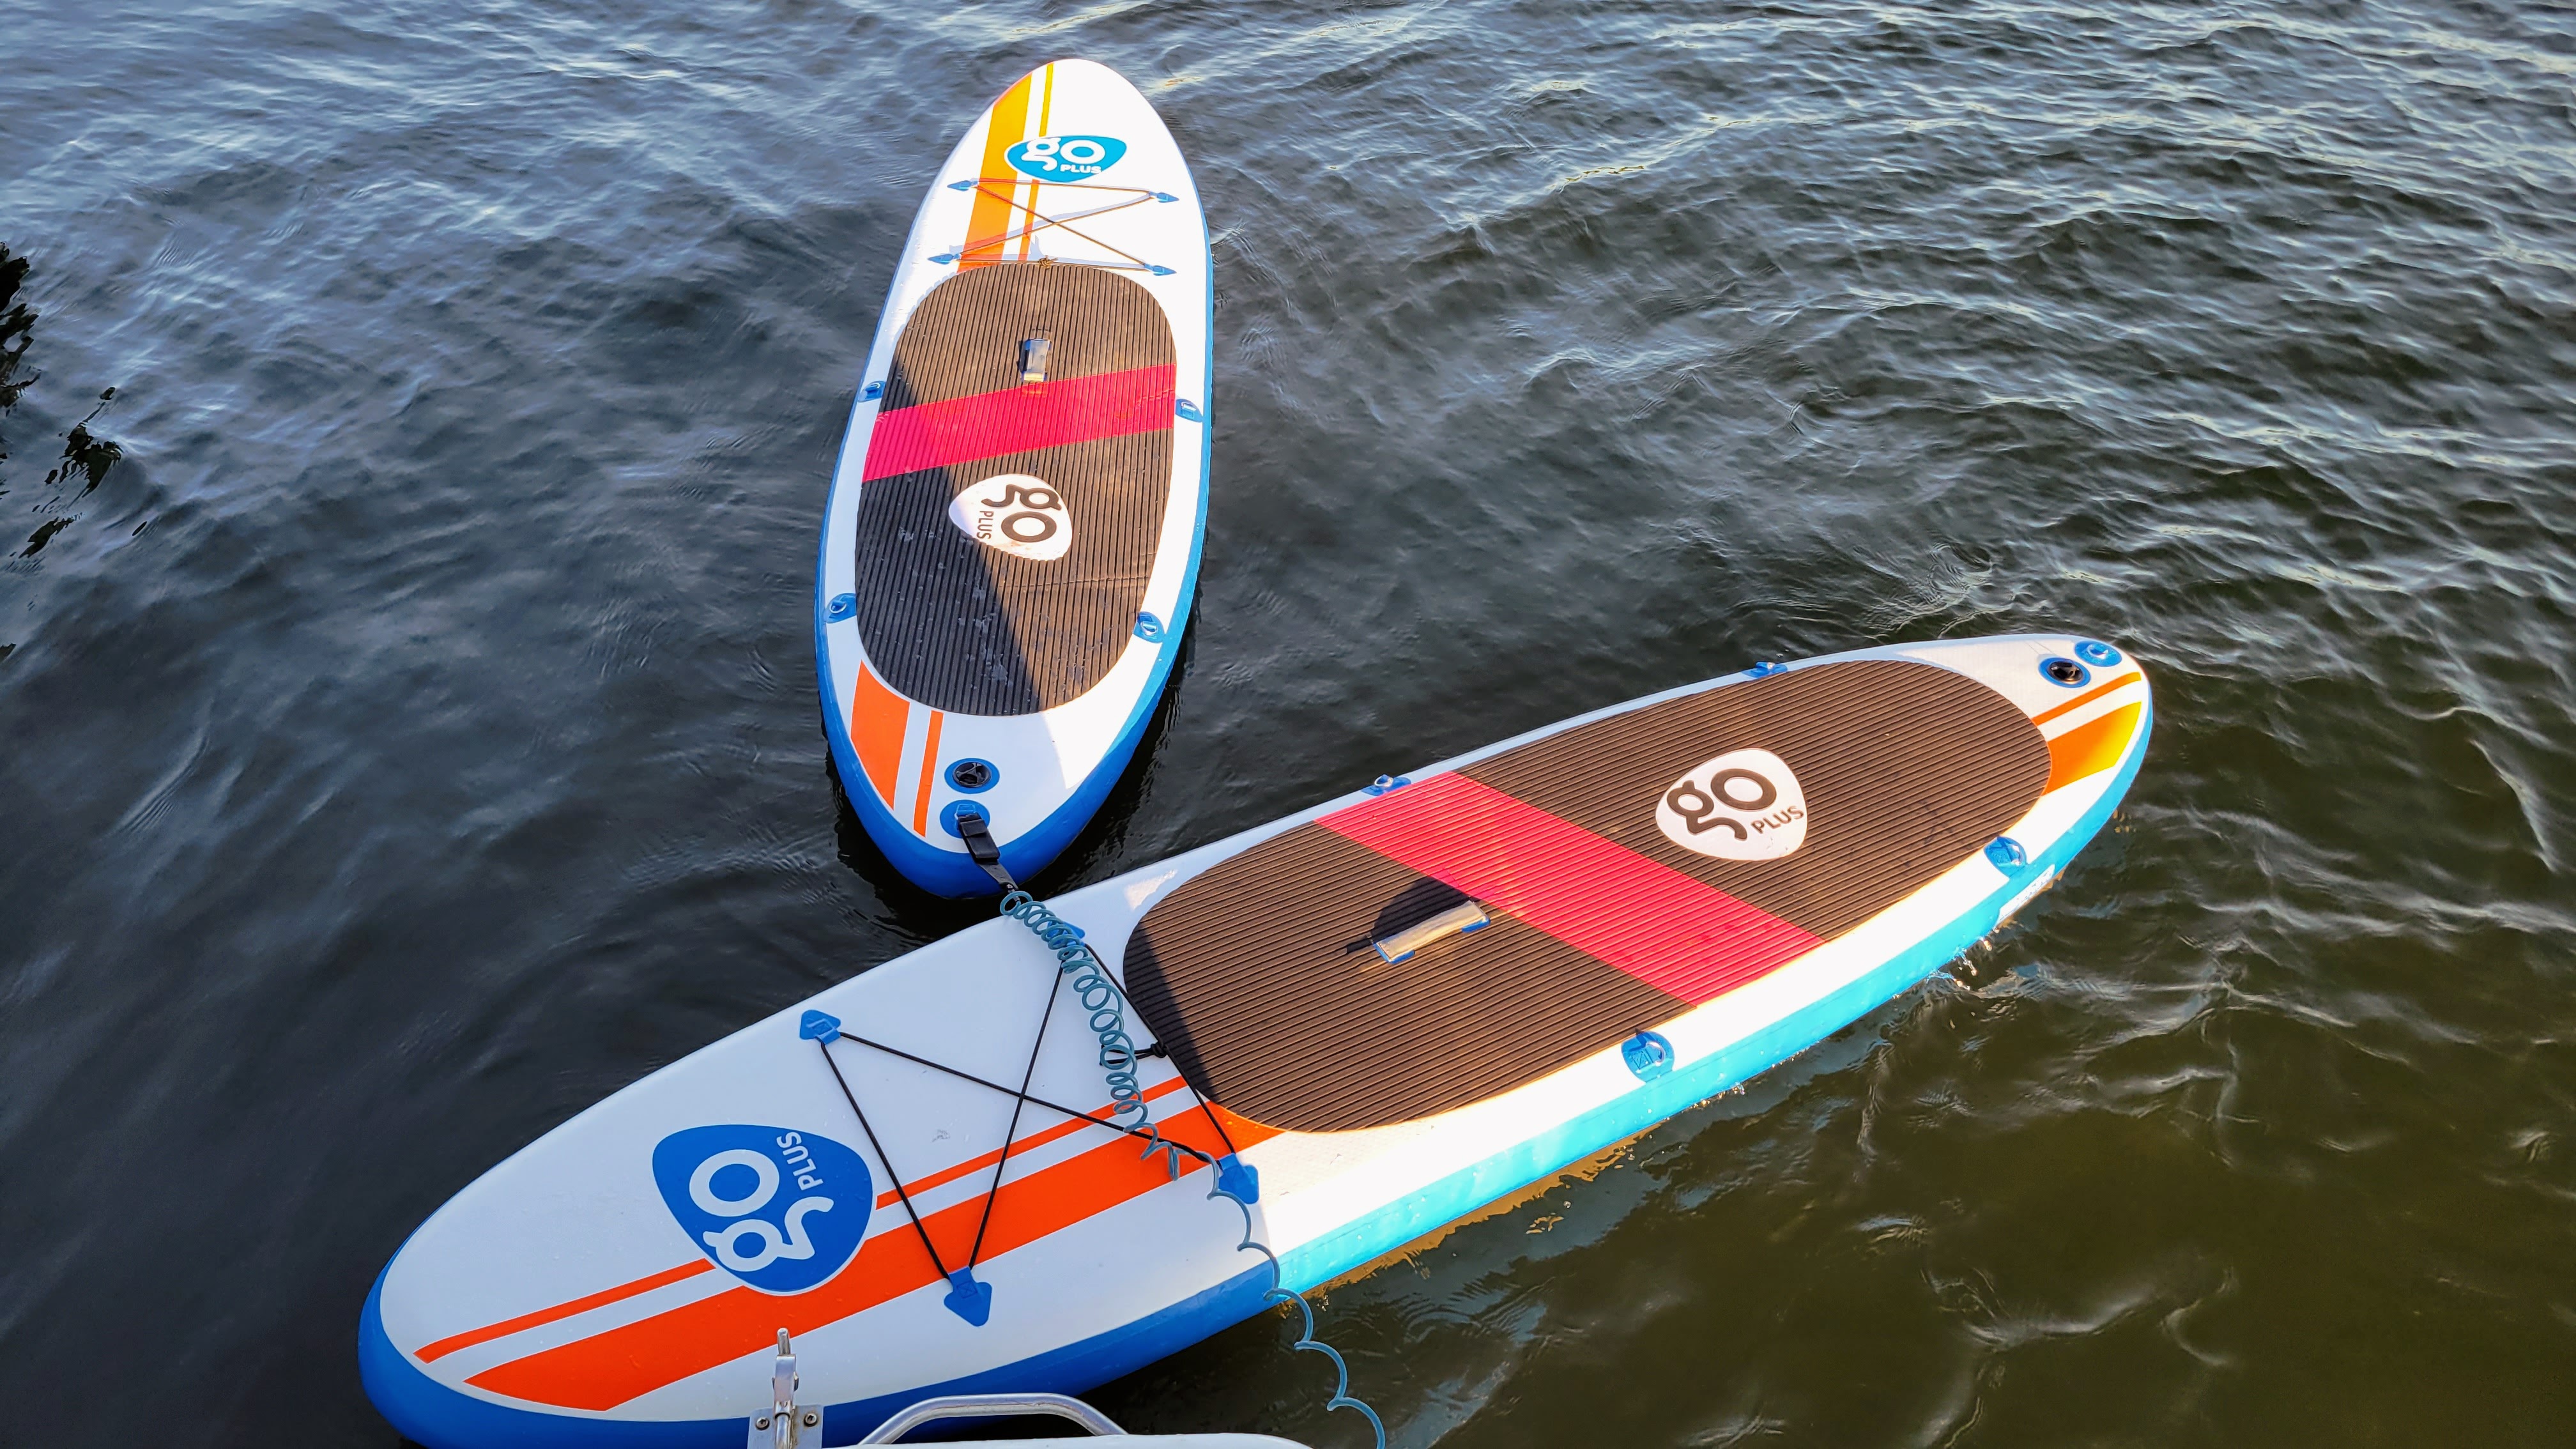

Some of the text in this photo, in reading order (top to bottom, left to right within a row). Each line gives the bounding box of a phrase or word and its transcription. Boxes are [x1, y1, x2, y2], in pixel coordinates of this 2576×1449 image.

[1021, 137, 1105, 171] go
[1060, 164, 1101, 174] PLUS
[976, 510, 994, 539] PLUS
[981, 484, 1062, 542] go
[1666, 768, 1777, 841] go
[1751, 805, 1804, 834] PLUS
[776, 1131, 824, 1191] PLUS
[689, 1149, 834, 1272] go
